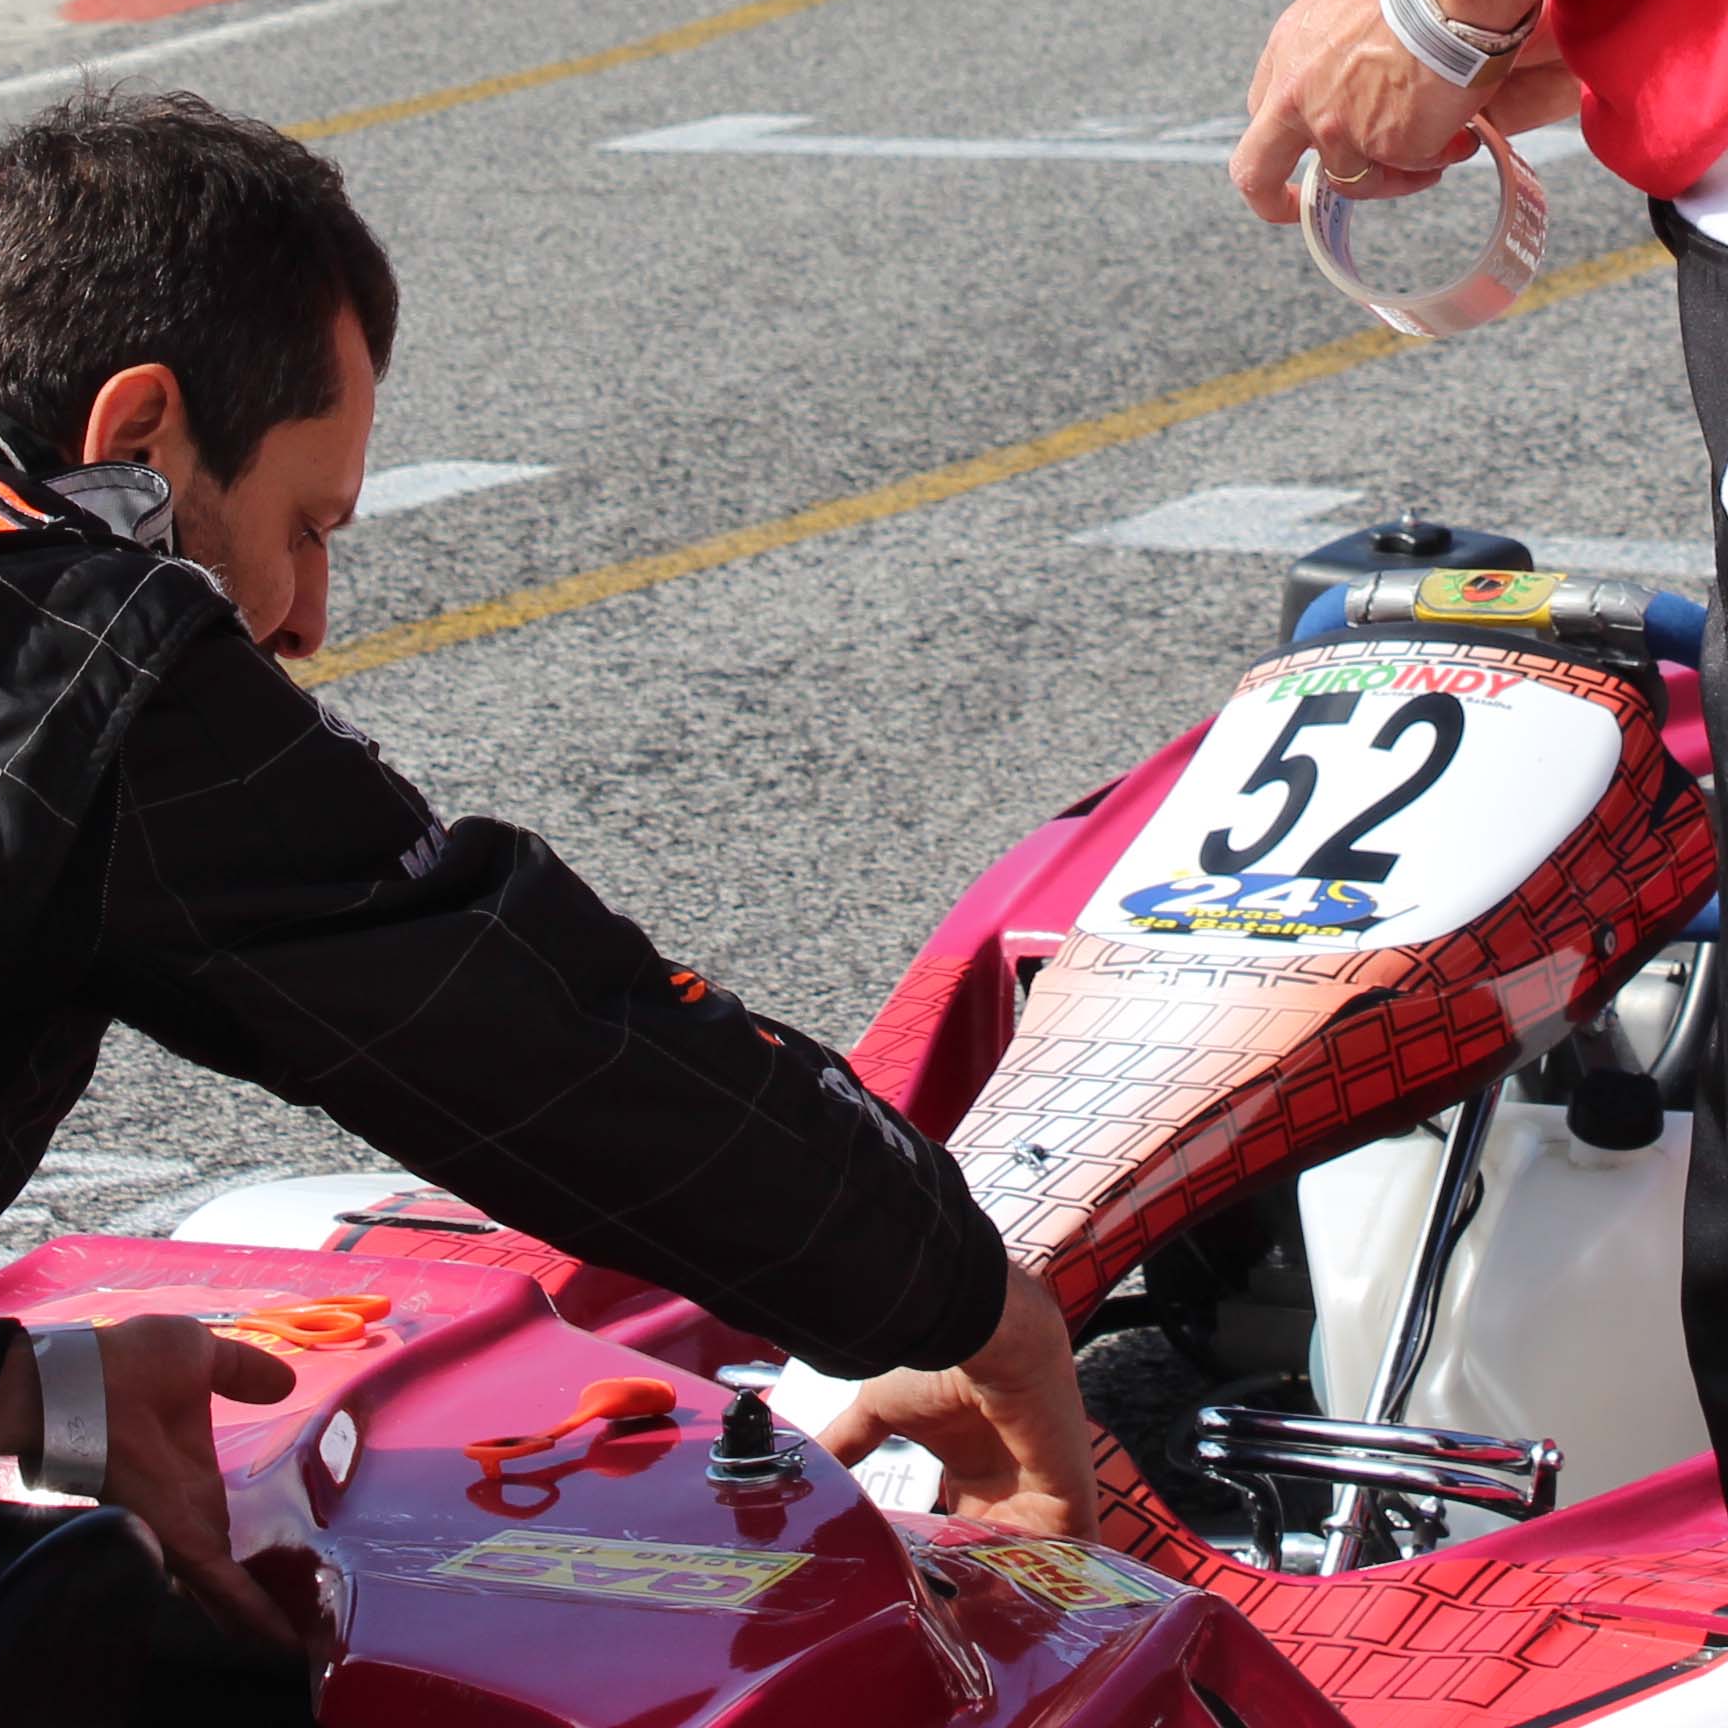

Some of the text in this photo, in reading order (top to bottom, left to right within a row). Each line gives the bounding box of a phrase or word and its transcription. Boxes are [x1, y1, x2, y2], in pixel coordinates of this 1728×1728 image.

[1267, 664, 1524, 703] EUROINDY
[1200, 691, 1465, 883] 52
[1152, 874, 1323, 917] 24
[1185, 906, 1285, 921] horas
[1129, 916, 1344, 937] da Batalha
[858, 1460, 915, 1507] irit
[462, 1550, 753, 1600] GAS
